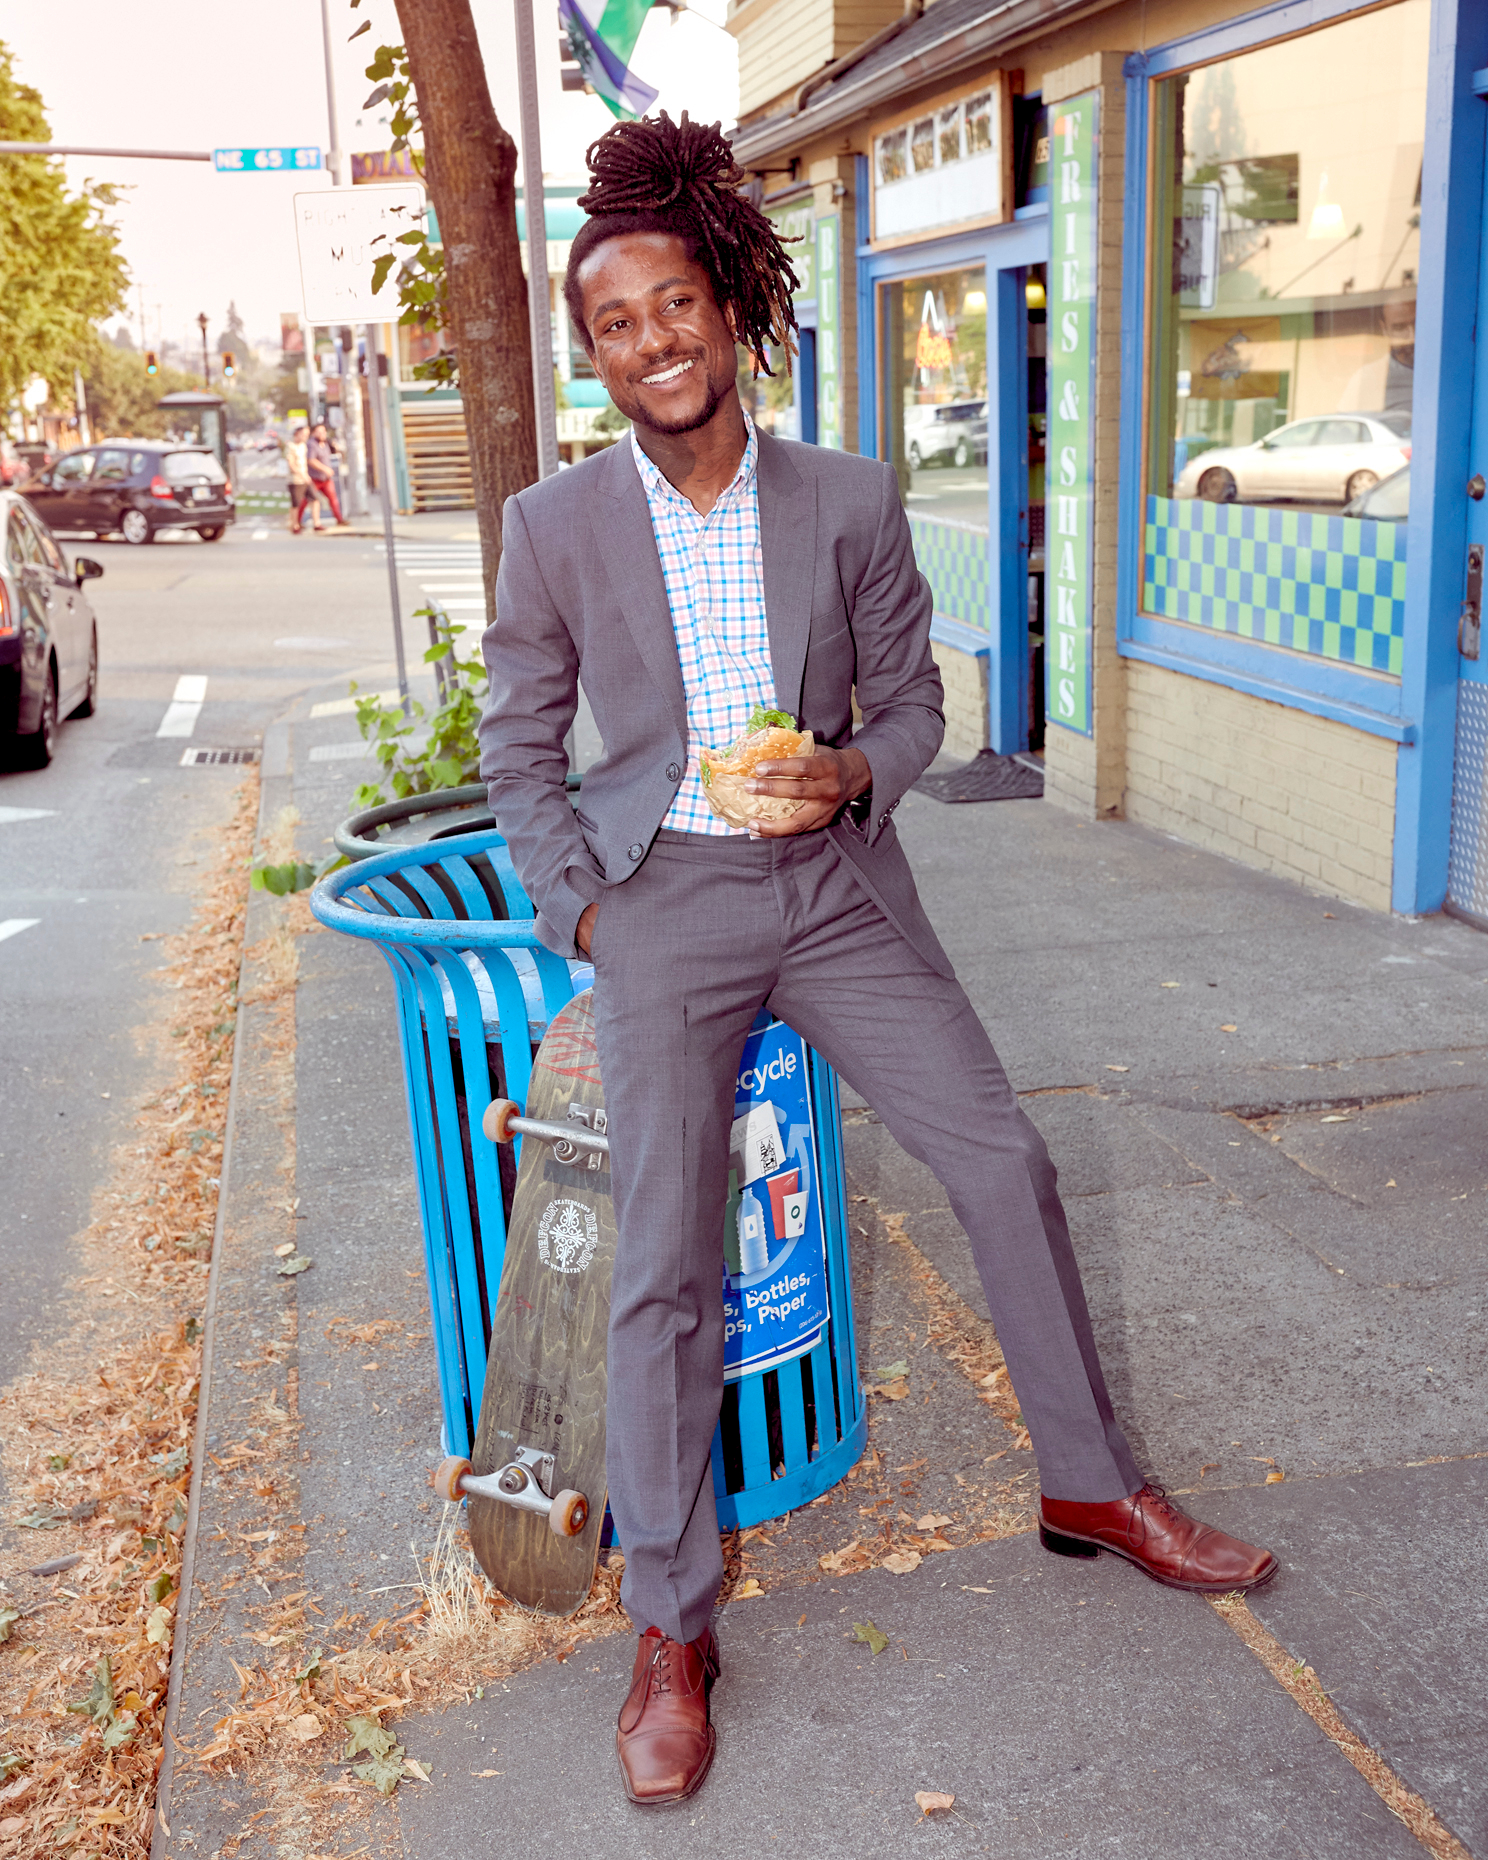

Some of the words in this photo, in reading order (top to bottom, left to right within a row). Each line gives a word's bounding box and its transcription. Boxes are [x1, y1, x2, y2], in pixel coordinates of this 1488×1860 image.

[215, 150, 244, 169] NE
[254, 149, 283, 168] 65
[294, 148, 319, 167] ST
[1060, 111, 1082, 354] FRIES
[1058, 379, 1080, 424] &
[1057, 445, 1079, 718] SHAKES
[731, 1121, 758, 1143] ews
[537, 1202, 559, 1260] DEFCON
[576, 1212, 598, 1271] DEFCON
[745, 1272, 811, 1309] Bottles,
[757, 1291, 807, 1325] Paper
